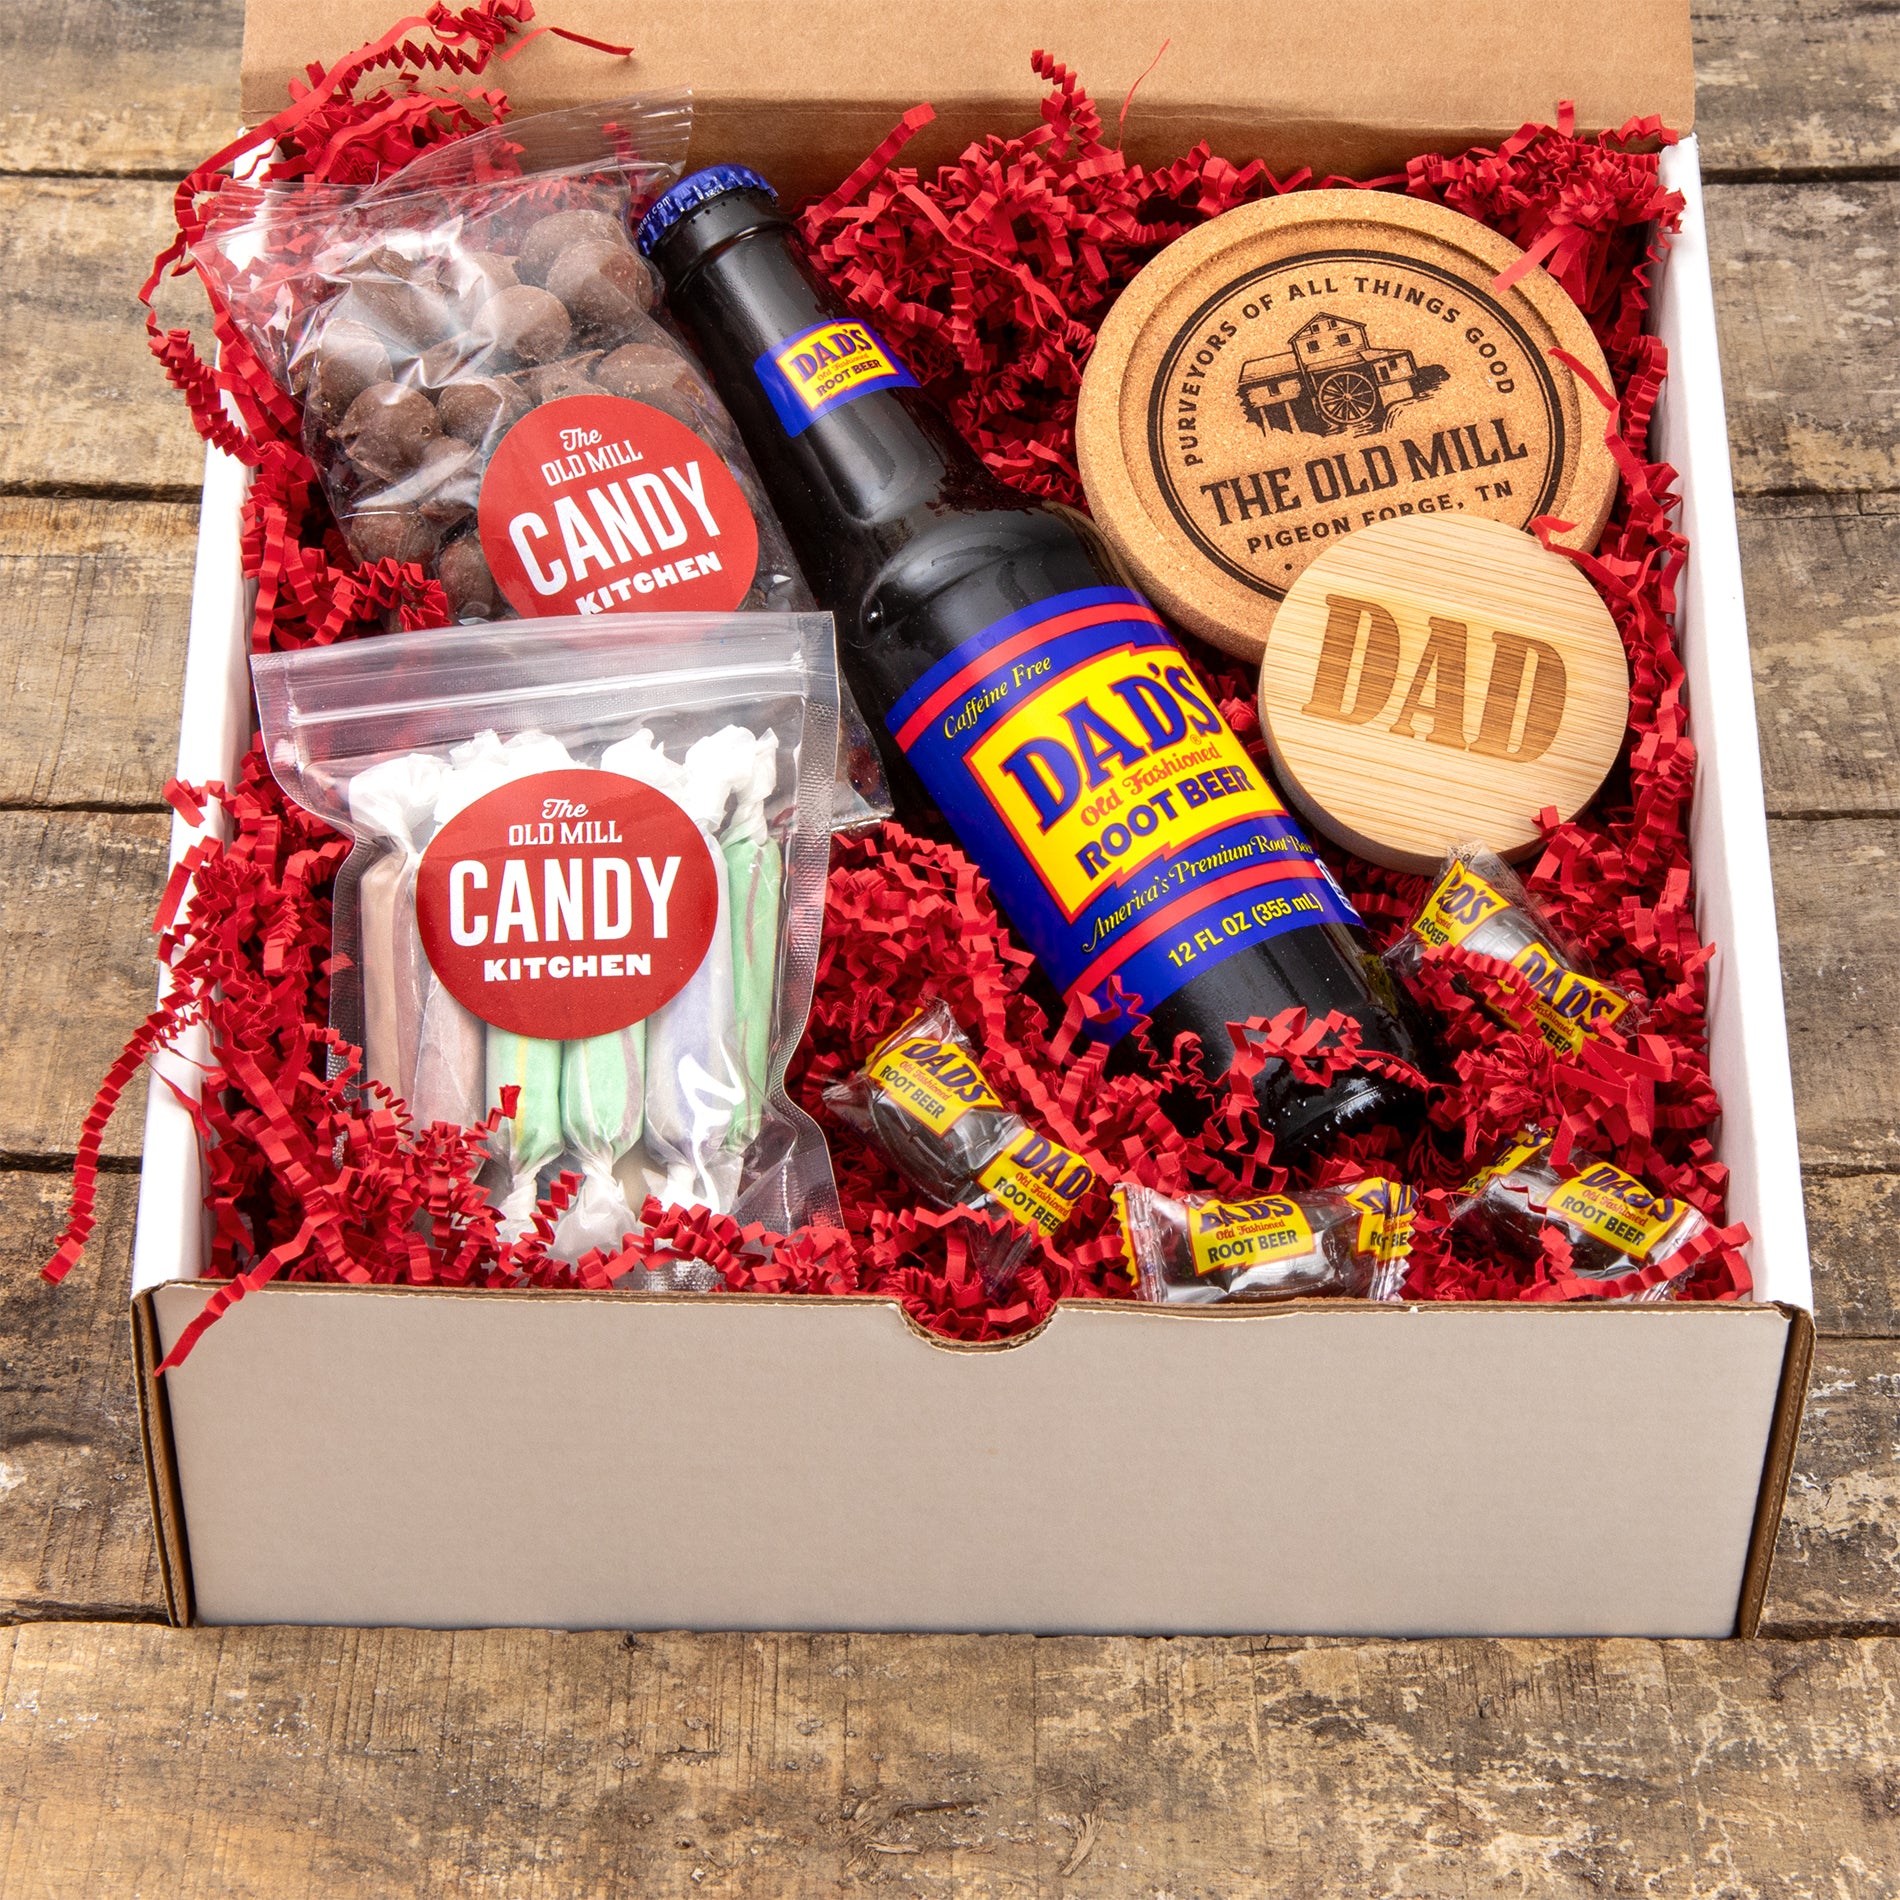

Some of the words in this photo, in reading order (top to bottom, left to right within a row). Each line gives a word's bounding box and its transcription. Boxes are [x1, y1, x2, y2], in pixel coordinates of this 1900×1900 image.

[791, 328, 872, 383] DAD'S
[815, 369, 851, 397] ROOT
[851, 359, 882, 375] BEER
[1177, 322, 1238, 468] PURVEYORS
[1242, 294, 1275, 321] OF
[1288, 277, 1339, 300] ALL
[1354, 277, 1461, 324] THINGS
[1464, 326, 1515, 394] GOOD
[541, 454, 586, 487] OLD
[586, 440, 643, 473] MILL
[559, 427, 602, 451] The
[1201, 468, 1301, 527] THE
[1305, 445, 1405, 505] OLD
[1401, 417, 1528, 482] MILL
[508, 461, 721, 596] CANDY
[1247, 517, 1351, 555] PIGEON
[1475, 481, 1512, 502] TN
[575, 551, 723, 616] KITCHEN
[943, 680, 1009, 740] Caffeine
[1012, 656, 1052, 689] Free
[1301, 593, 1567, 763] DAD
[1002, 663, 1223, 835] DAD'S
[541, 798, 589, 819] The
[1081, 795, 1123, 828] Old
[1122, 745, 1222, 796] Fashioned
[508, 823, 554, 846] OLD
[560, 820, 622, 845] MILL
[1075, 794, 1176, 881] ROOT
[1176, 765, 1255, 808] BEER
[450, 856, 682, 947] CANDY
[1082, 876, 1171, 953] America's
[1168, 844, 1254, 885] Premium
[1250, 835, 1289, 854] Root
[1168, 944, 1196, 968] 12
[1194, 928, 1222, 955] FL
[1223, 912, 1252, 937] OZ
[1250, 897, 1293, 927] (355
[1291, 892, 1324, 913] mL)
[483, 953, 651, 982] KITCHEN
[879, 1064, 915, 1093] ROOT
[911, 1086, 946, 1119] BEER
[901, 1042, 996, 1104] DAD'S
[1009, 1133, 1094, 1200] DAD
[993, 1176, 1037, 1212] ROOT
[1032, 1205, 1062, 1233] BEE
[1200, 1198, 1294, 1235] DAD'S
[1216, 1228, 1235, 1241] Old
[1237, 1219, 1286, 1236] Fashioned
[1560, 1195, 1607, 1224] ROOT
[1604, 1216, 1647, 1246] BEER
[1207, 1238, 1254, 1263] ROOT
[1257, 1229, 1298, 1250] BEER
